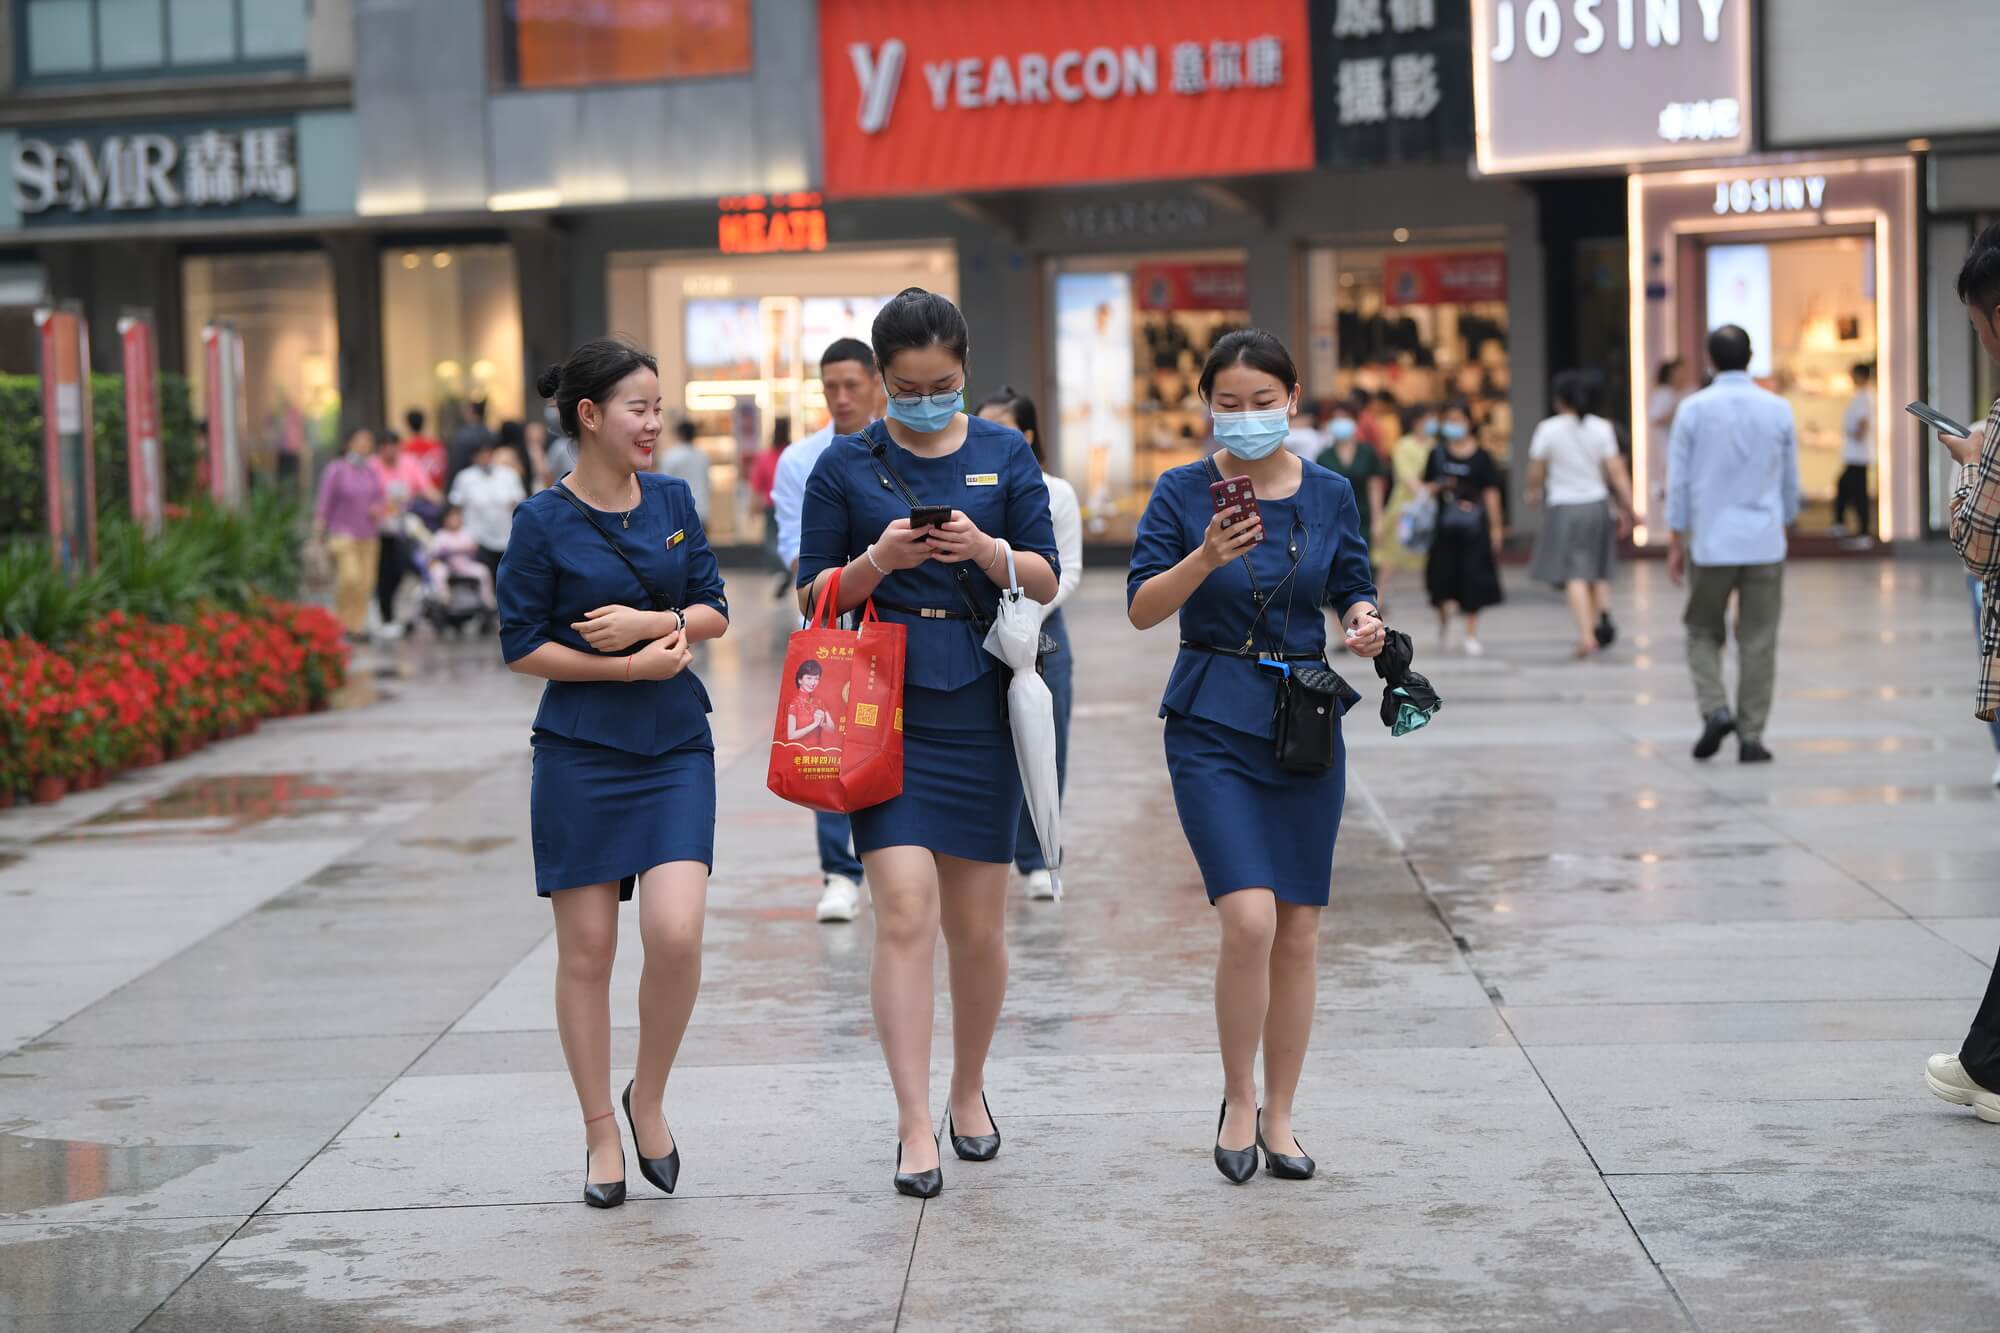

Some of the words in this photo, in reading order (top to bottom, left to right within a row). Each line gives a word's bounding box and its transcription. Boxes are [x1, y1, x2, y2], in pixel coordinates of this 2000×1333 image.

[1490, 0, 1726, 62] JOSINY
[923, 46, 1159, 110] YEARCON
[1713, 176, 1826, 214] JOSINY
